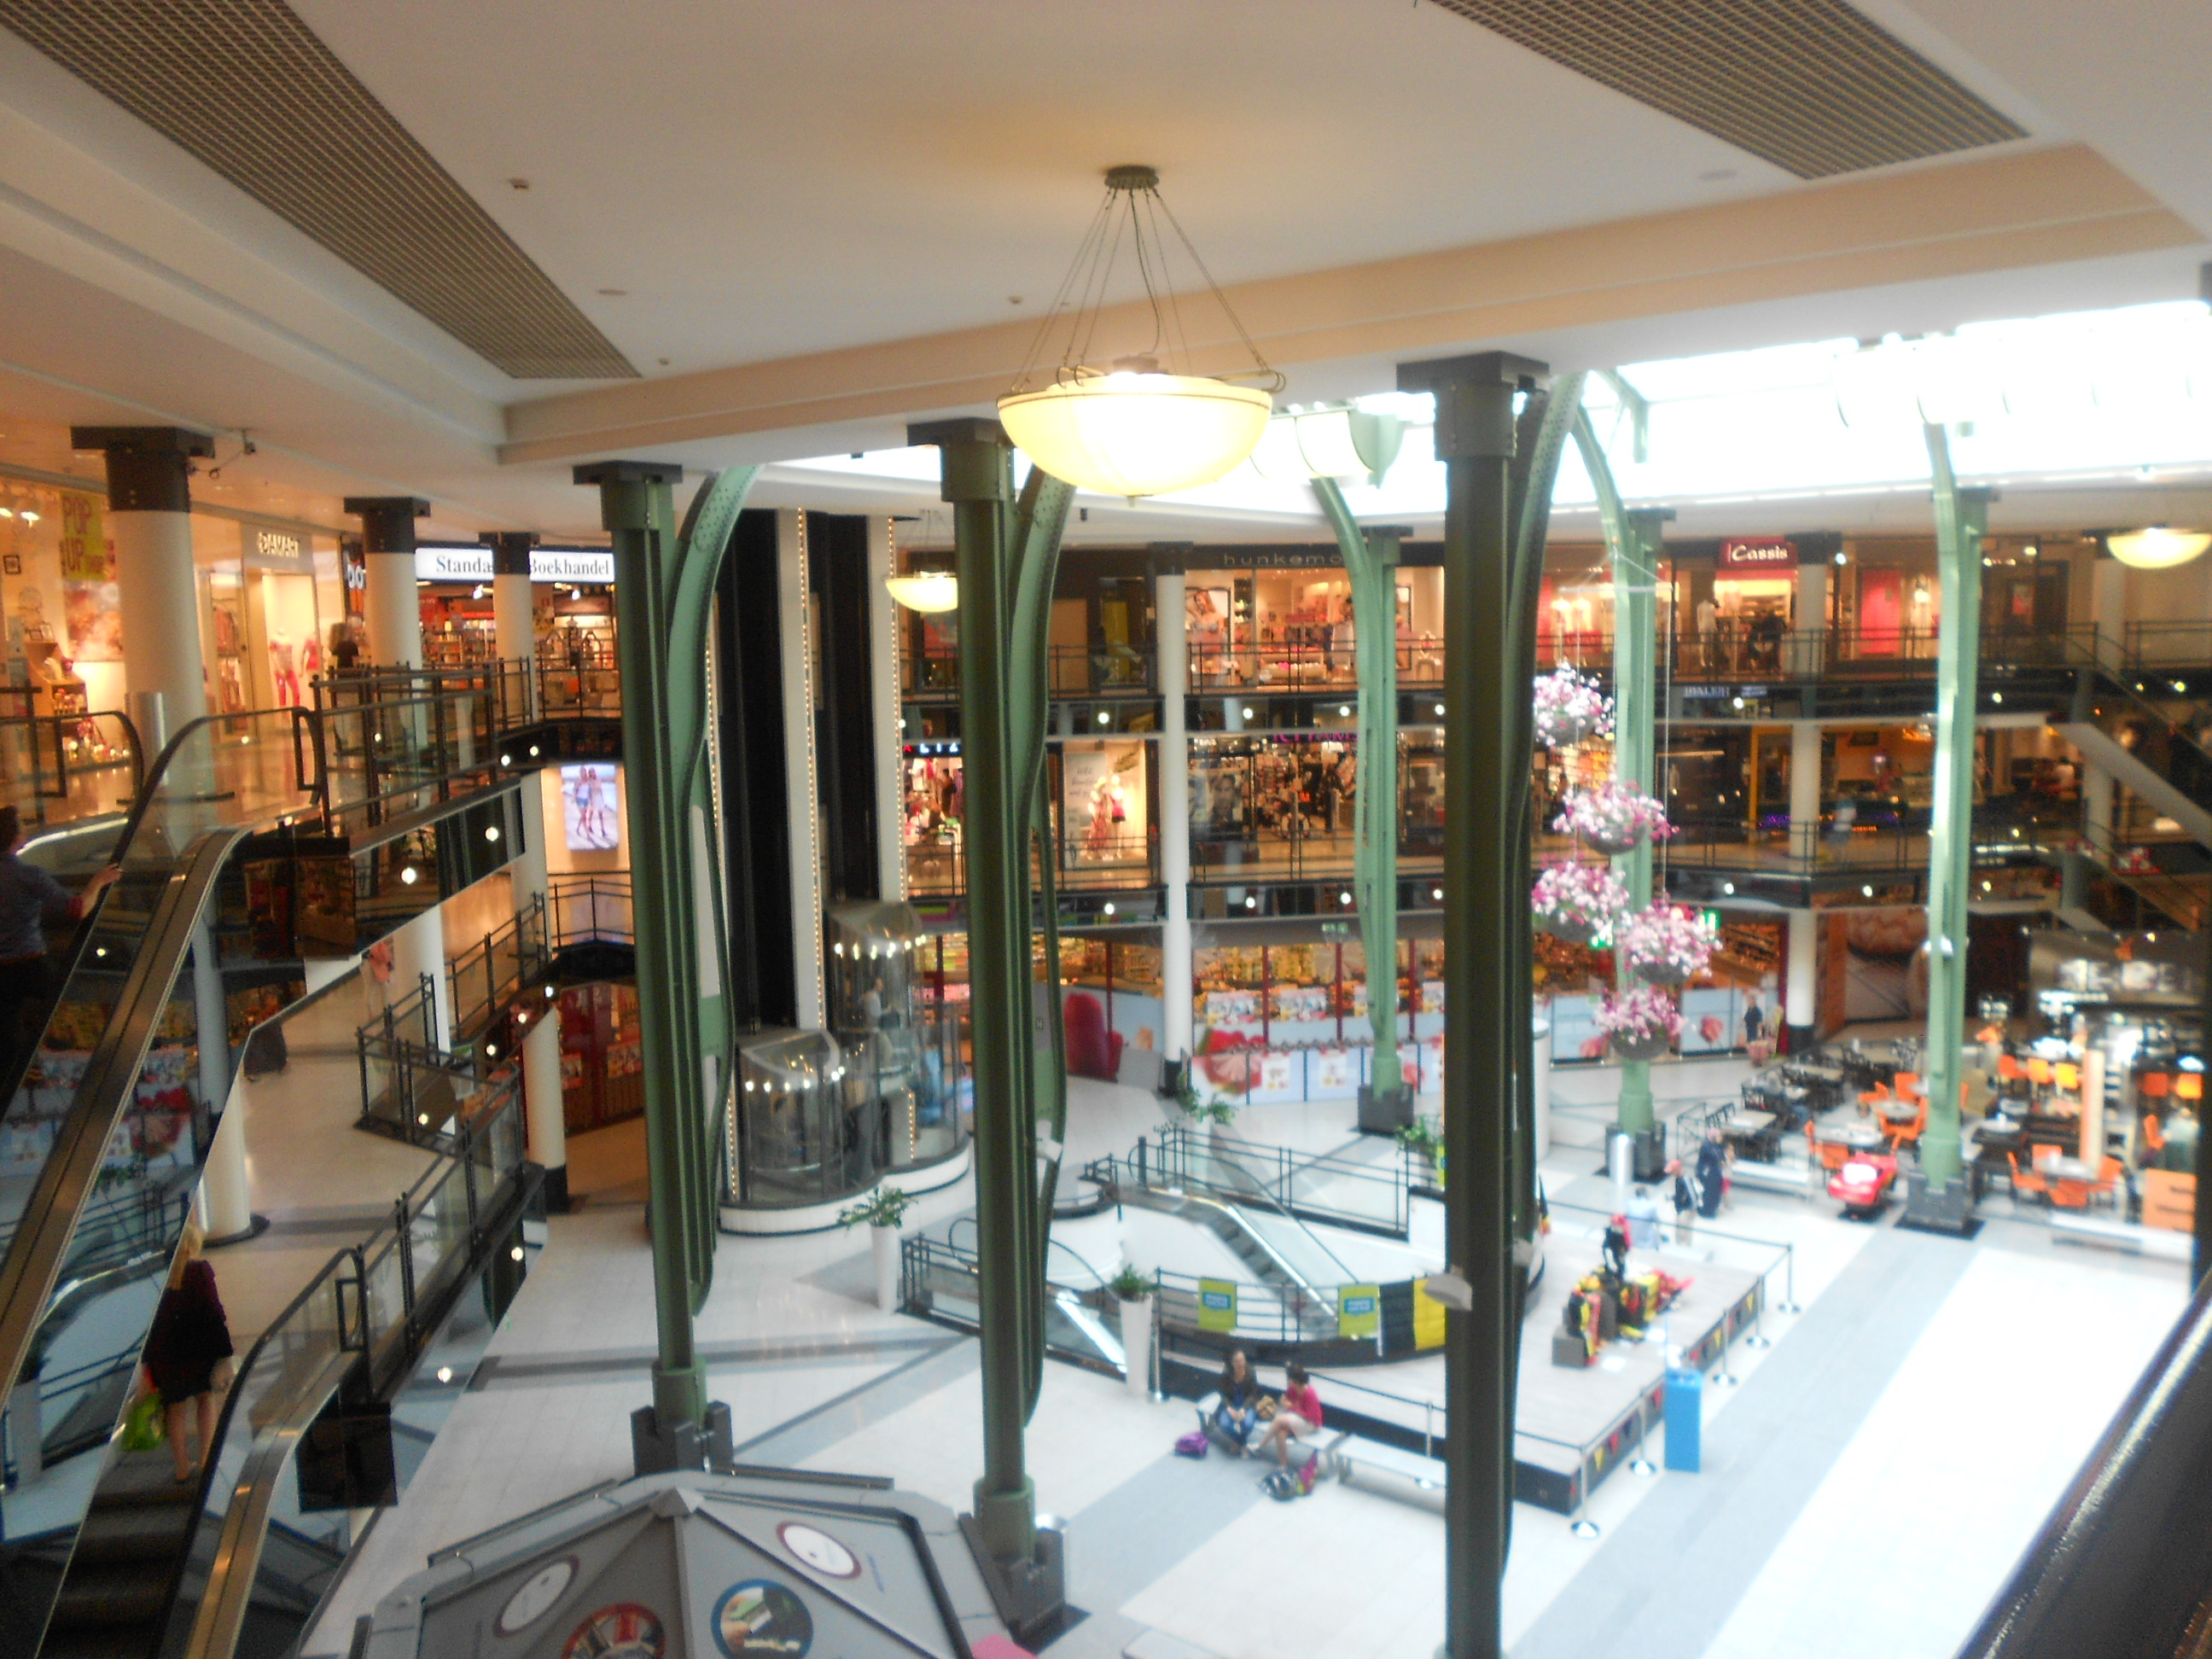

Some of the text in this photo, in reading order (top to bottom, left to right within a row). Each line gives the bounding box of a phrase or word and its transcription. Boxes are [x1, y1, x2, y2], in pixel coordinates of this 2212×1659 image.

[258, 531, 300, 559] DAMART
[1732, 544, 1788, 562] Cassis
[436, 555, 608, 576] Standa Boekhandel
[1223, 553, 1344, 565] hunkemo
